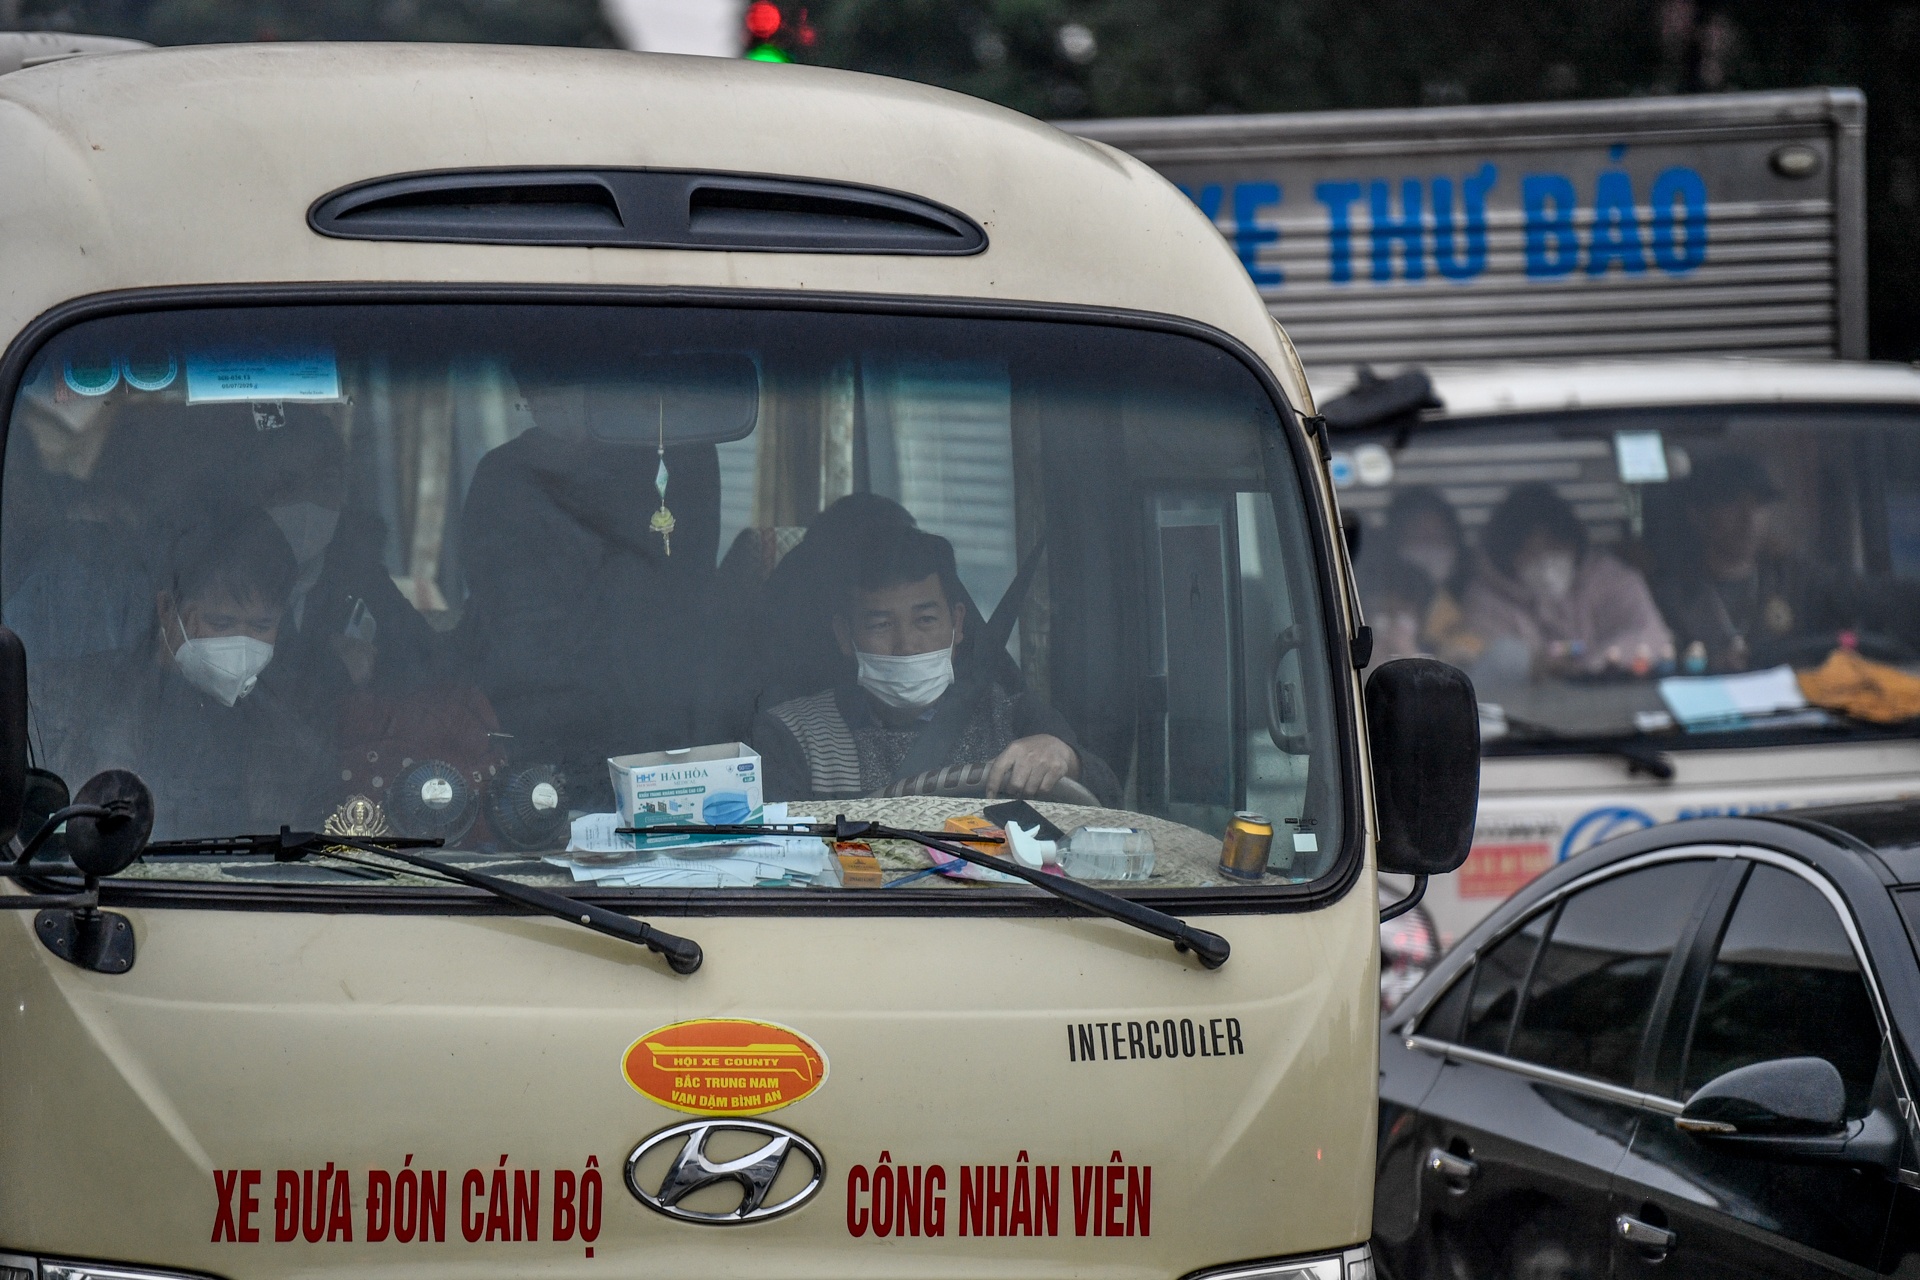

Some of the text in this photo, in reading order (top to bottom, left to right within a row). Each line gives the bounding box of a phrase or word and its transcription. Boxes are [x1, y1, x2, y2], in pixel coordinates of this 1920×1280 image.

[1312, 161, 1499, 285] THƯ
[1520, 143, 1710, 282] BÁO
[684, 767, 709, 780] HÒA
[673, 1056, 779, 1067] HỘI XE COUNTY
[675, 1073, 779, 1088] BẮC TRUNG NAM
[671, 1089, 782, 1109] VẠN DẶM BÌNH AN
[847, 1151, 1150, 1237] CÔNG NHÂN VIÊN
[213, 1154, 602, 1257] XE ĐƯA ĐÓN CÁN BỘ
